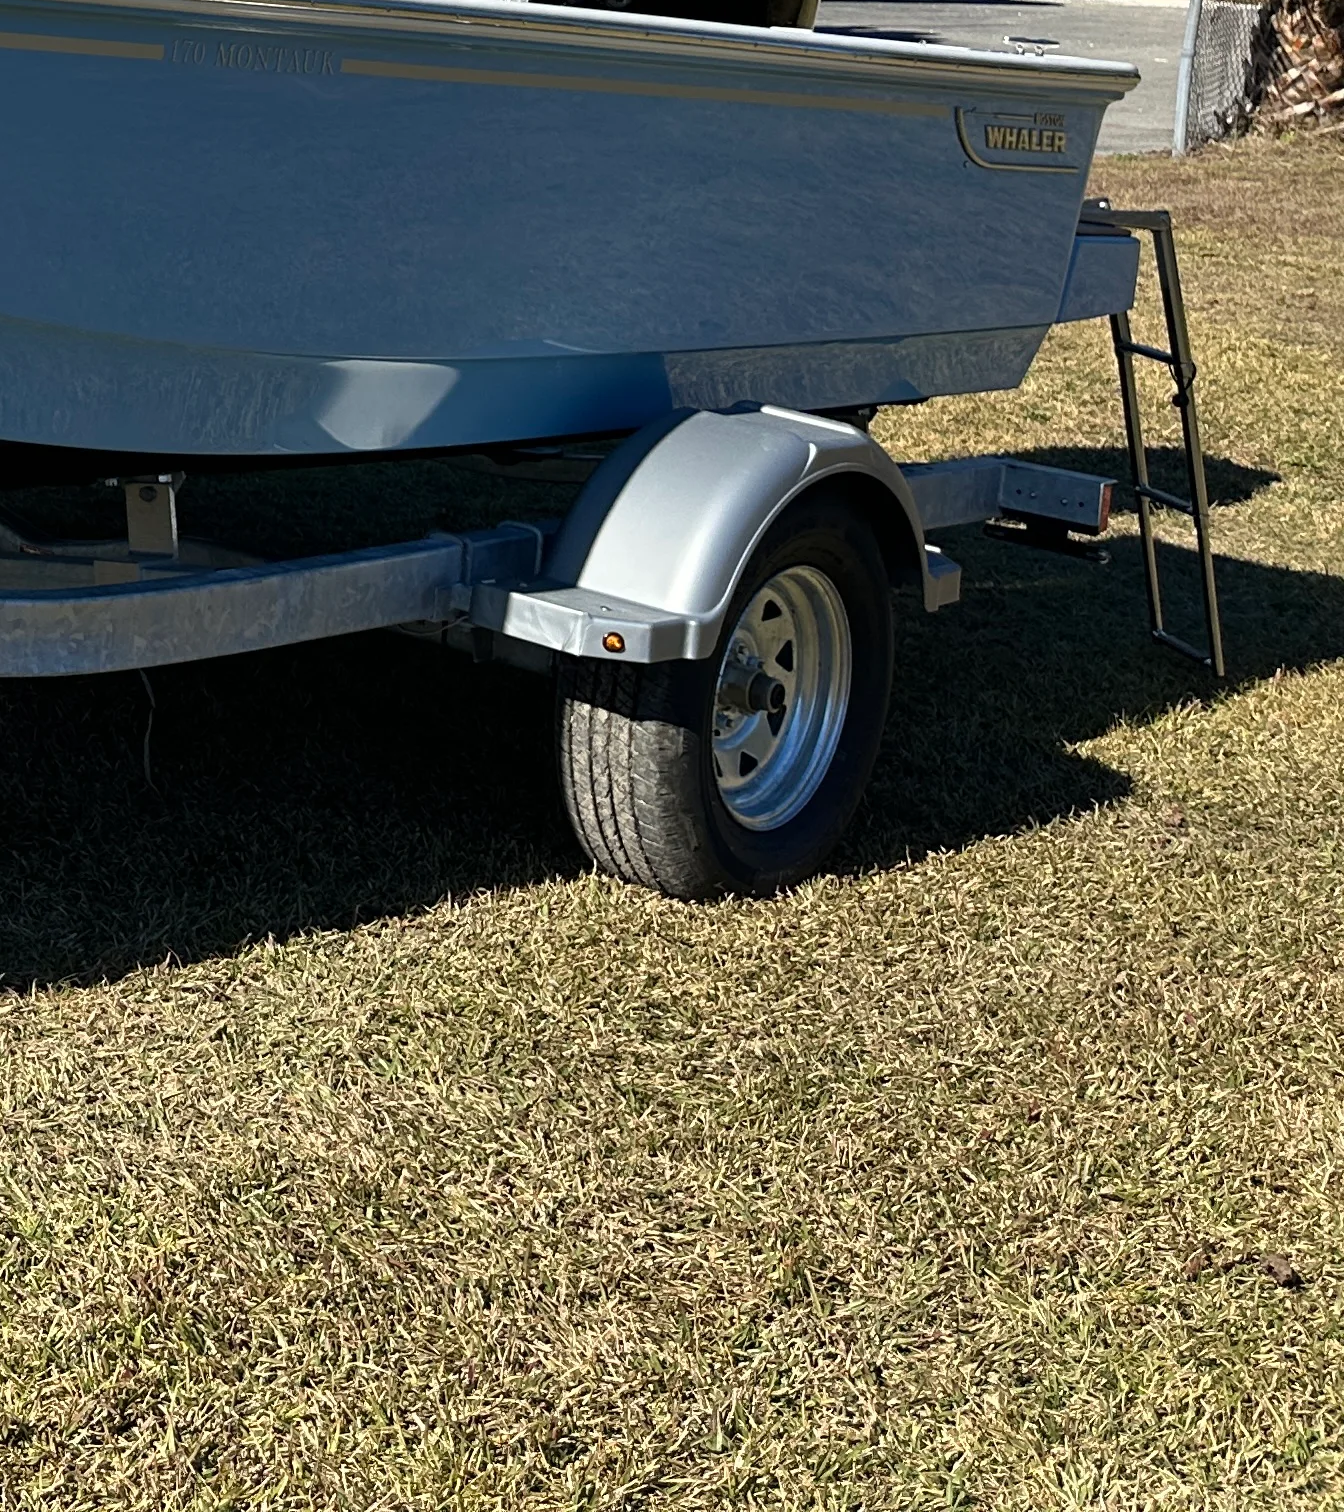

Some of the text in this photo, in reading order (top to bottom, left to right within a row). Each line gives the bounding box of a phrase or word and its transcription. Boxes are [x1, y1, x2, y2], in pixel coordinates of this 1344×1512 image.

[170, 39, 335, 76] 170 MONTAUK
[986, 125, 1067, 152] WHALER
